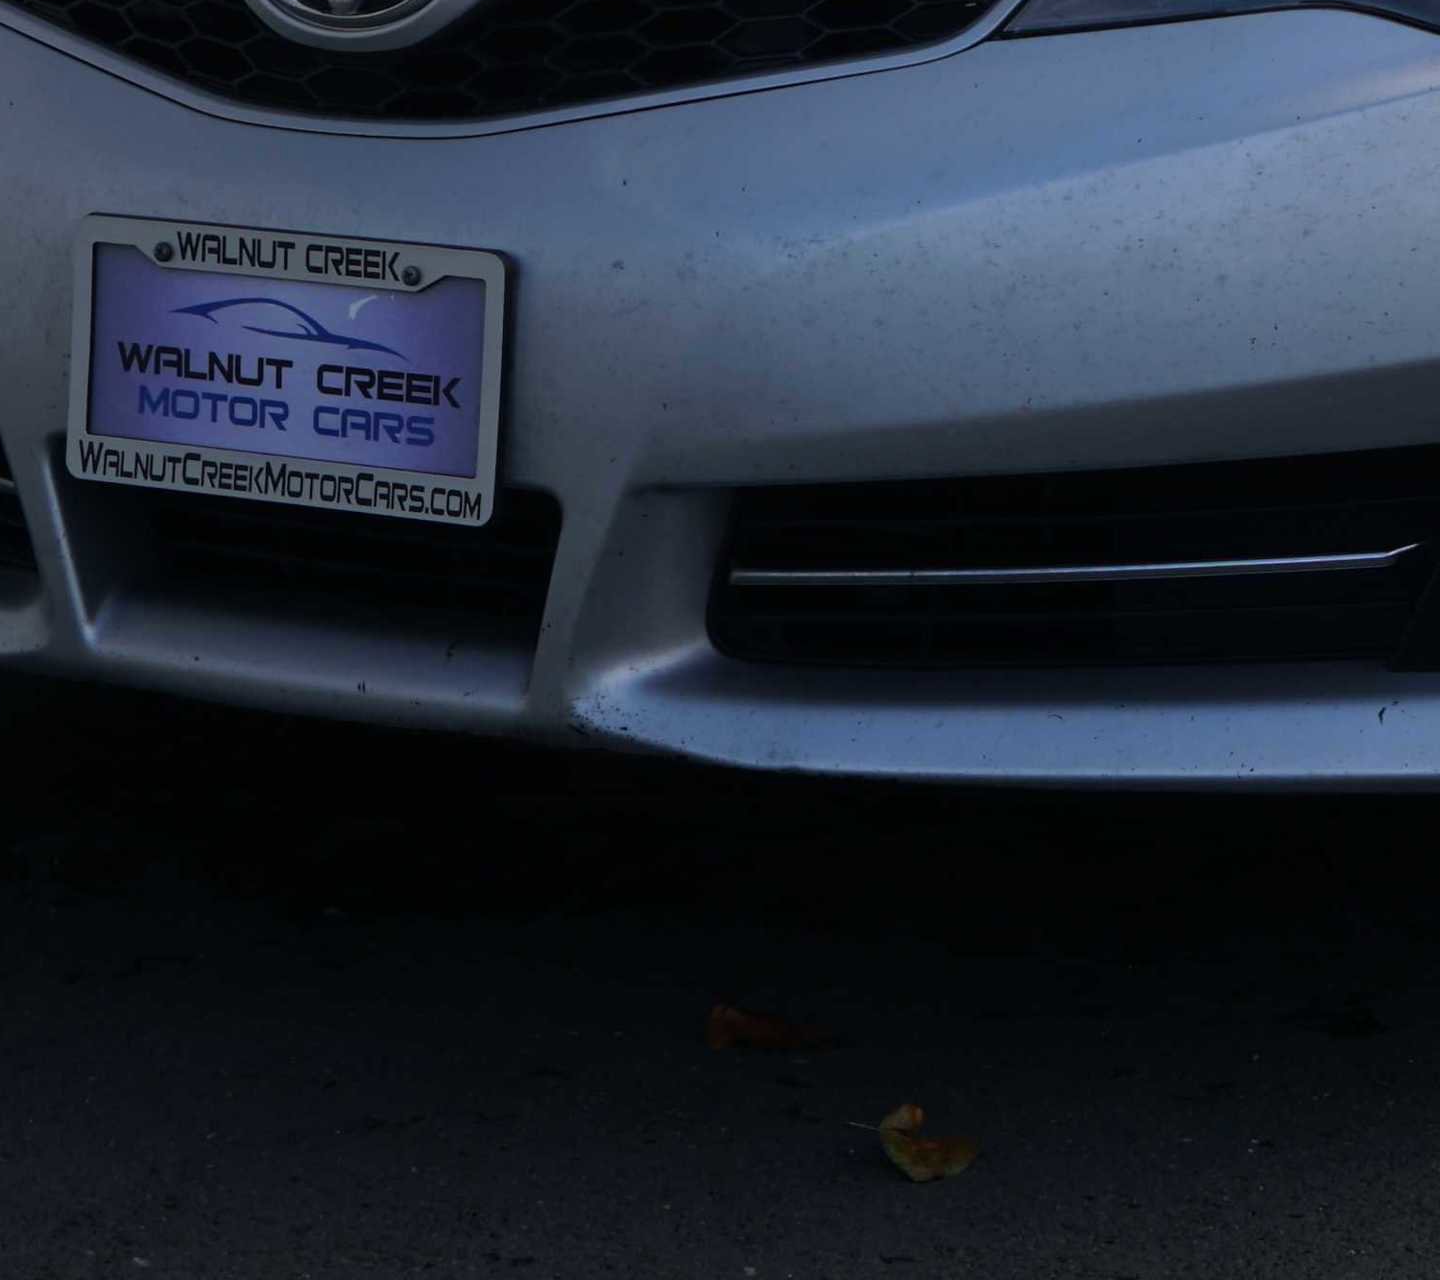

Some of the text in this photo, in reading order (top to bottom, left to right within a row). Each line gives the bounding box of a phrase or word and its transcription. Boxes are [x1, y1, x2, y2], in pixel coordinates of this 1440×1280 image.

[177, 231, 400, 282] WALNUT CREEK
[118, 341, 461, 408] WALNUT CREEK
[138, 385, 435, 447] MOTOR CARS
